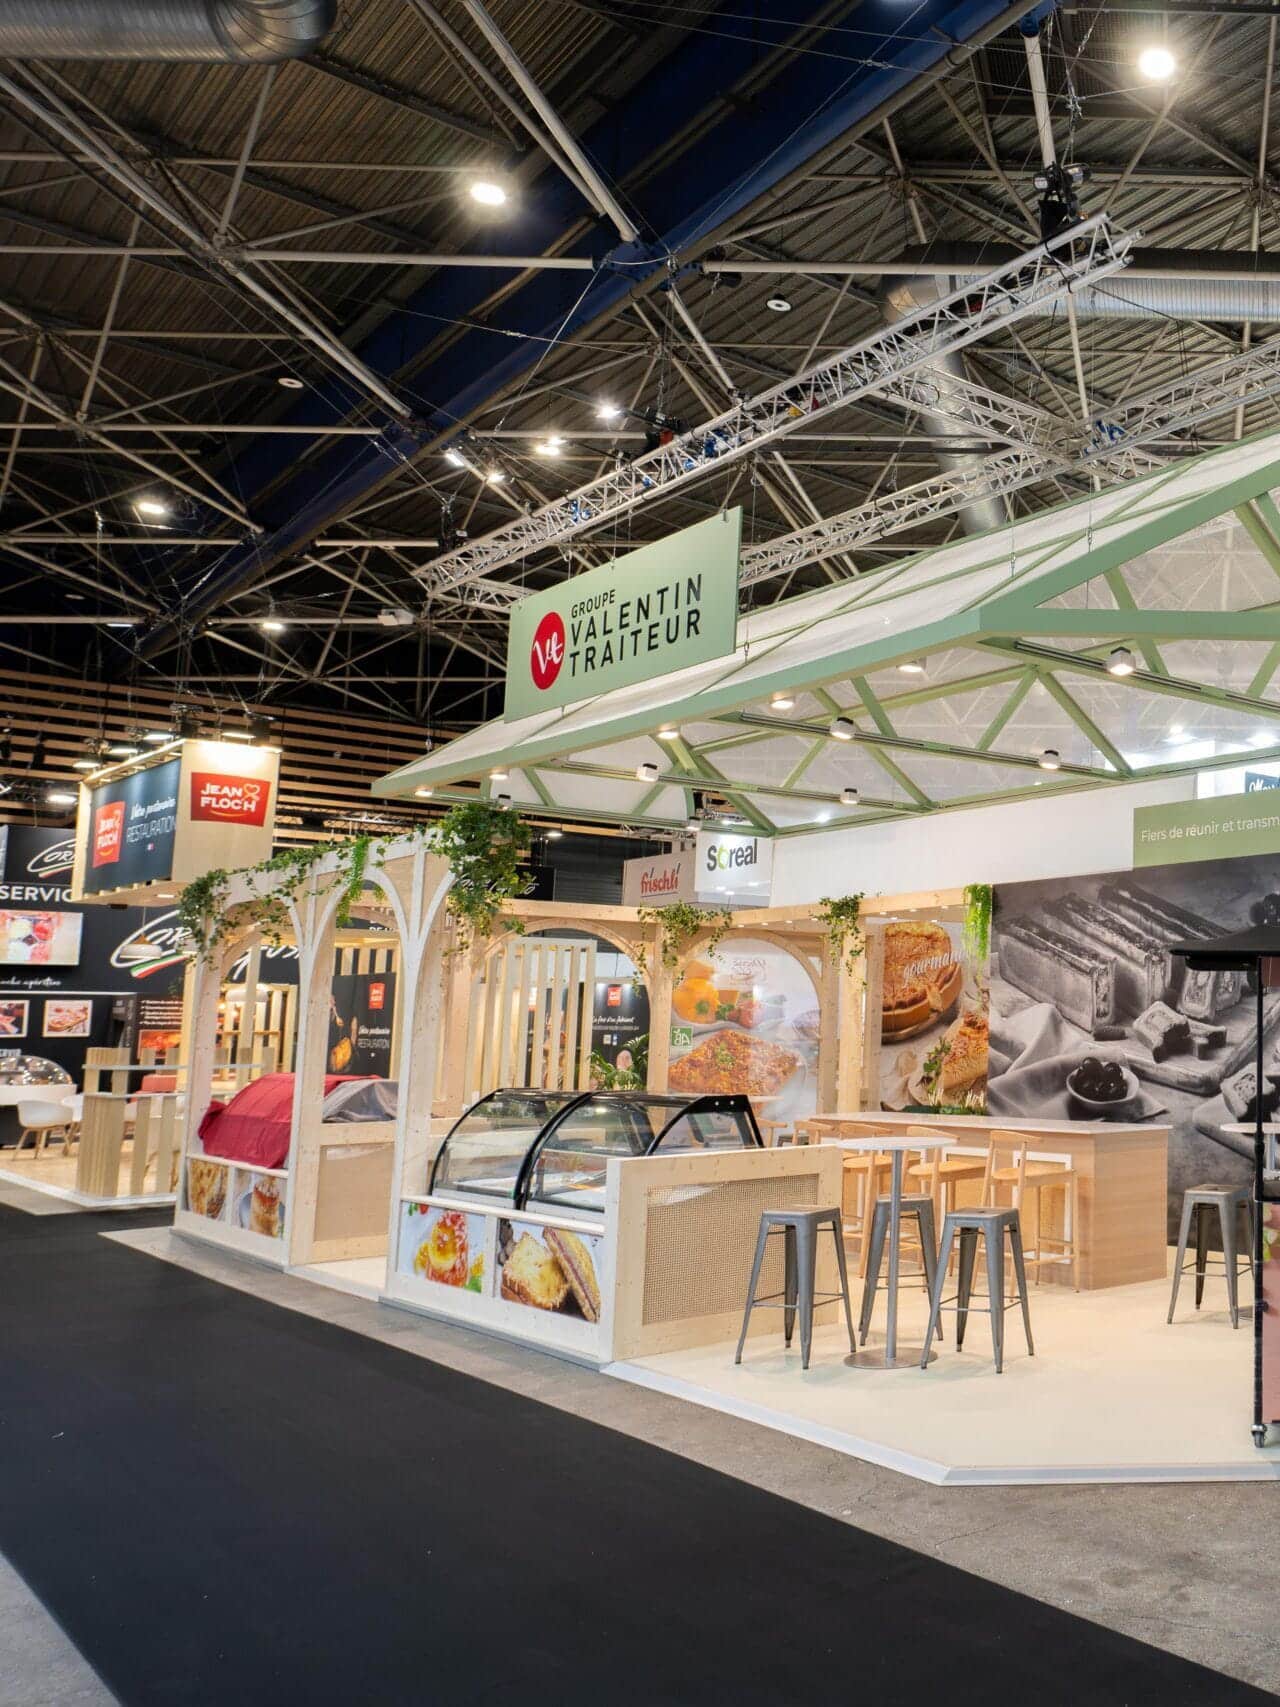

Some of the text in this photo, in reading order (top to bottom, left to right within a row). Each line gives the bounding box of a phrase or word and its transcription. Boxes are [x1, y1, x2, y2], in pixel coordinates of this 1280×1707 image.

[571, 589, 615, 618] GROUPE
[571, 574, 701, 646] VALENTIN
[570, 609, 700, 677] TRAITEUR
[200, 783, 243, 797] JEAN
[200, 796, 257, 813] FLOCH
[1141, 829, 1167, 842] Fiers
[1169, 826, 1183, 838] de
[1186, 822, 1218, 836] réunir
[1222, 820, 1235, 833] et
[0, 884, 72, 902] SERVIC
